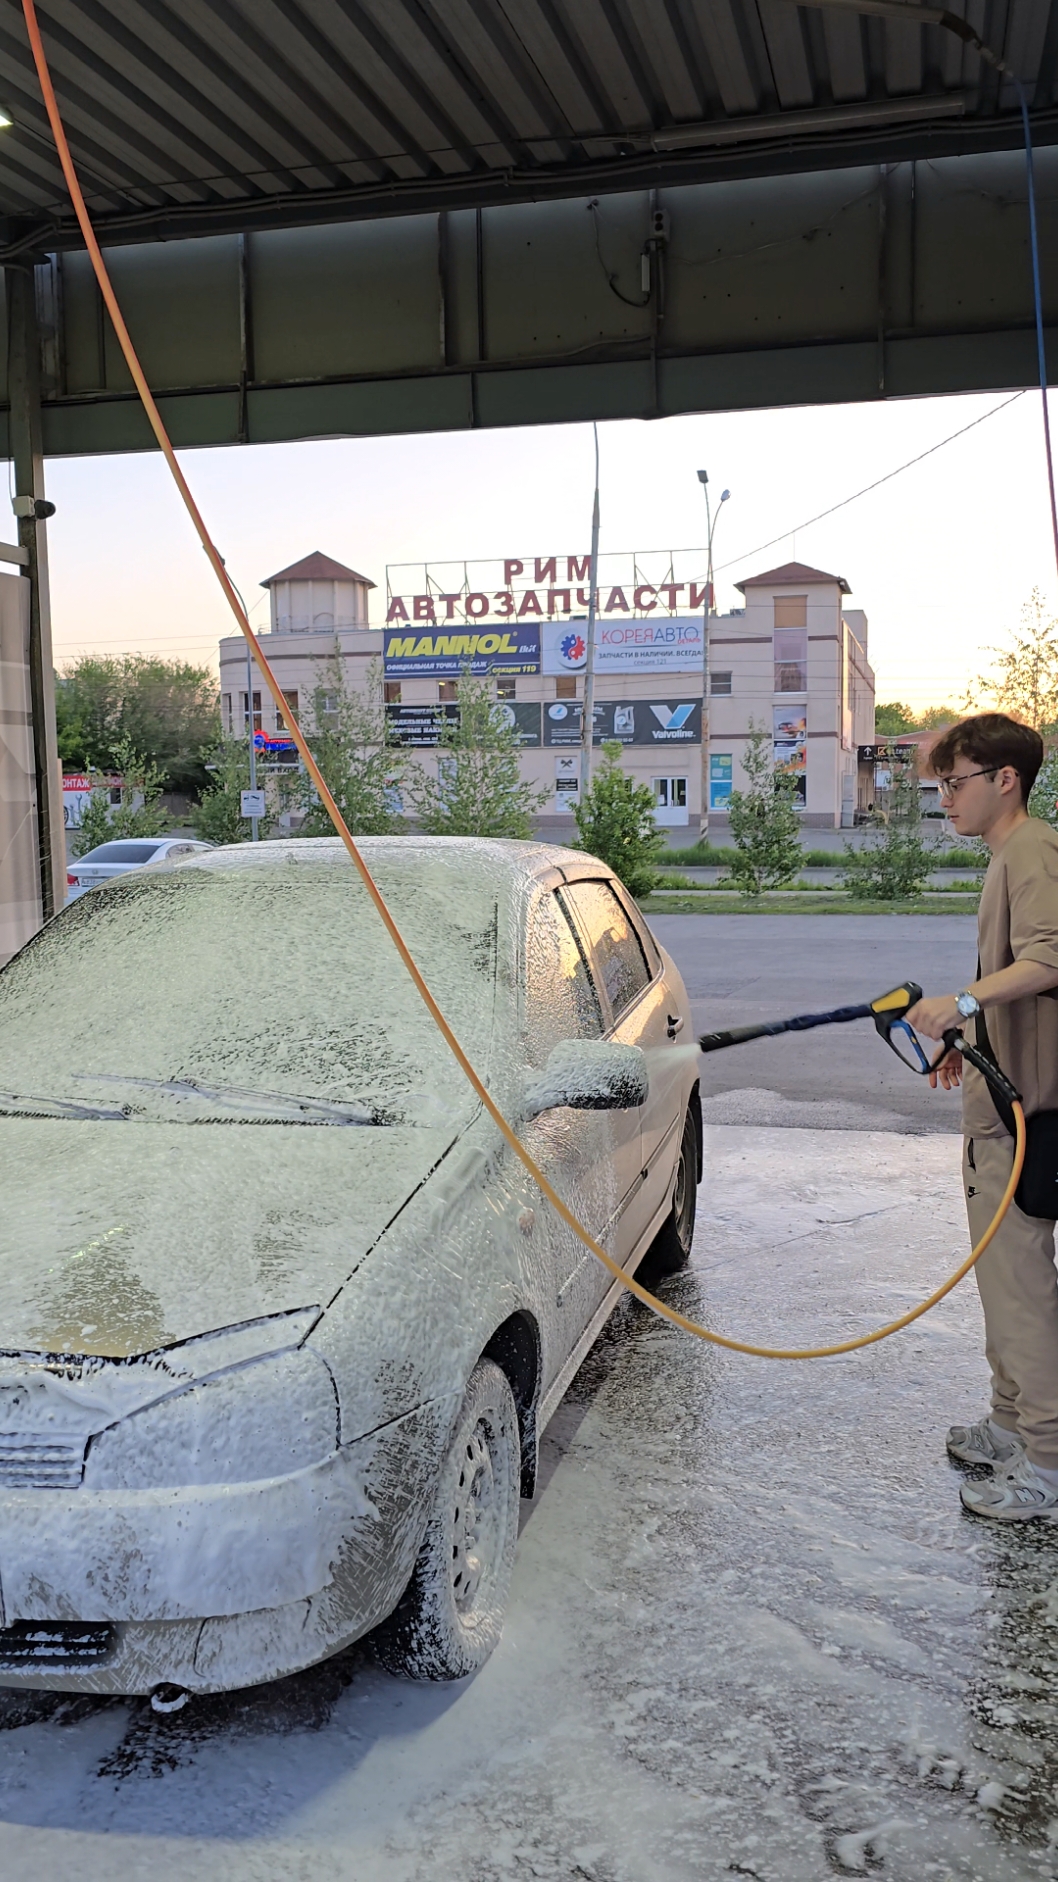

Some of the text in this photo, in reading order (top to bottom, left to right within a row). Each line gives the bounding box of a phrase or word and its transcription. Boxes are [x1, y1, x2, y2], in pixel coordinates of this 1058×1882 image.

[504, 555, 592, 585] РИМ
[385, 582, 714, 622] АВТОЗАПЧАСТИ
[386, 633, 517, 658] MANNOL
[386, 663, 435, 672] ОФИЦИАЛЬНАЯ
[436, 662, 457, 670] ТОЧКА
[522, 665, 537, 673] 119
[652, 729, 694, 739] Valvoline
